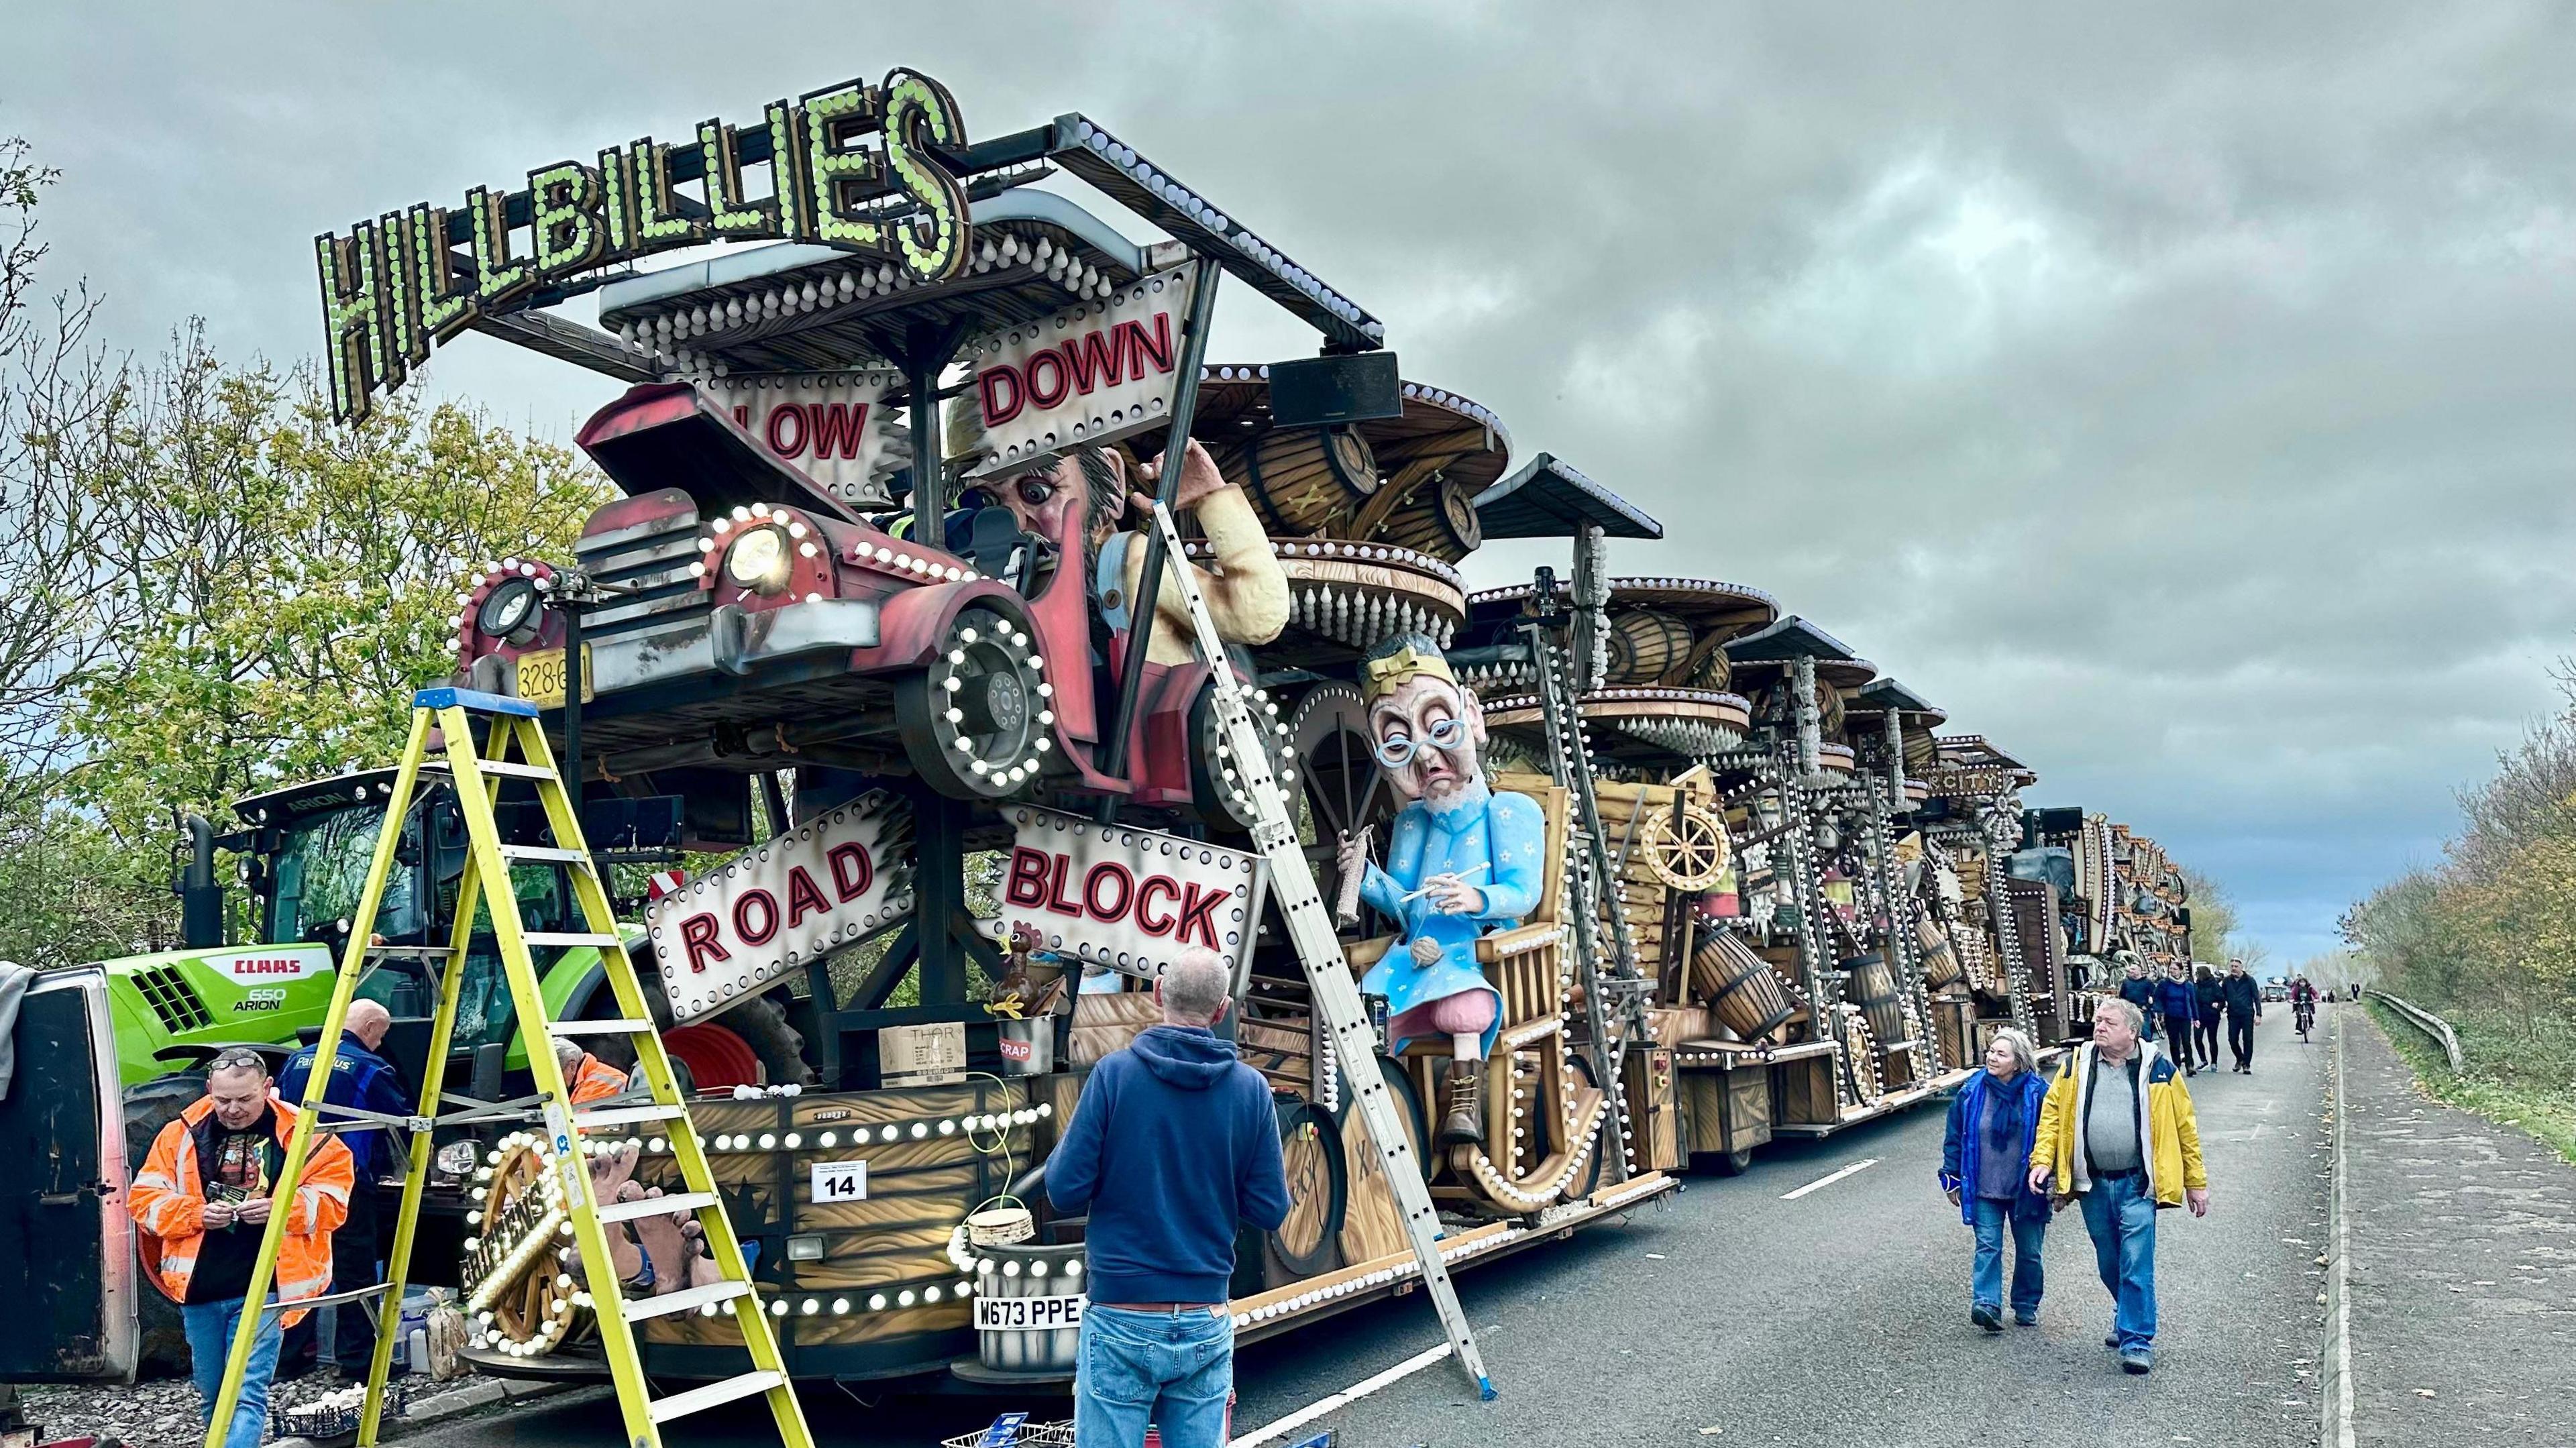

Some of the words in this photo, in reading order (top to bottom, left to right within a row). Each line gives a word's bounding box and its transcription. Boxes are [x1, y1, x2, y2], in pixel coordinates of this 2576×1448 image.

[315, 66, 971, 428] HILLBILLIES
[978, 312, 1174, 428] DOWN
[520, 655, 588, 698] 328-61
[1943, 773, 1997, 790] CITY
[286, 792, 348, 812] ARION
[679, 840, 873, 974] ROAD
[1005, 846, 1232, 952] BLOCK
[235, 960, 301, 973] CLAAS
[249, 989, 287, 1000] 650
[233, 1001, 280, 1011] ARION
[910, 1027, 954, 1041] THOR
[1000, 1042, 1029, 1057] CRAP
[825, 1176, 855, 1196] 14
[981, 1301, 1024, 1325] W673
[1032, 1298, 1079, 1325] PPE
